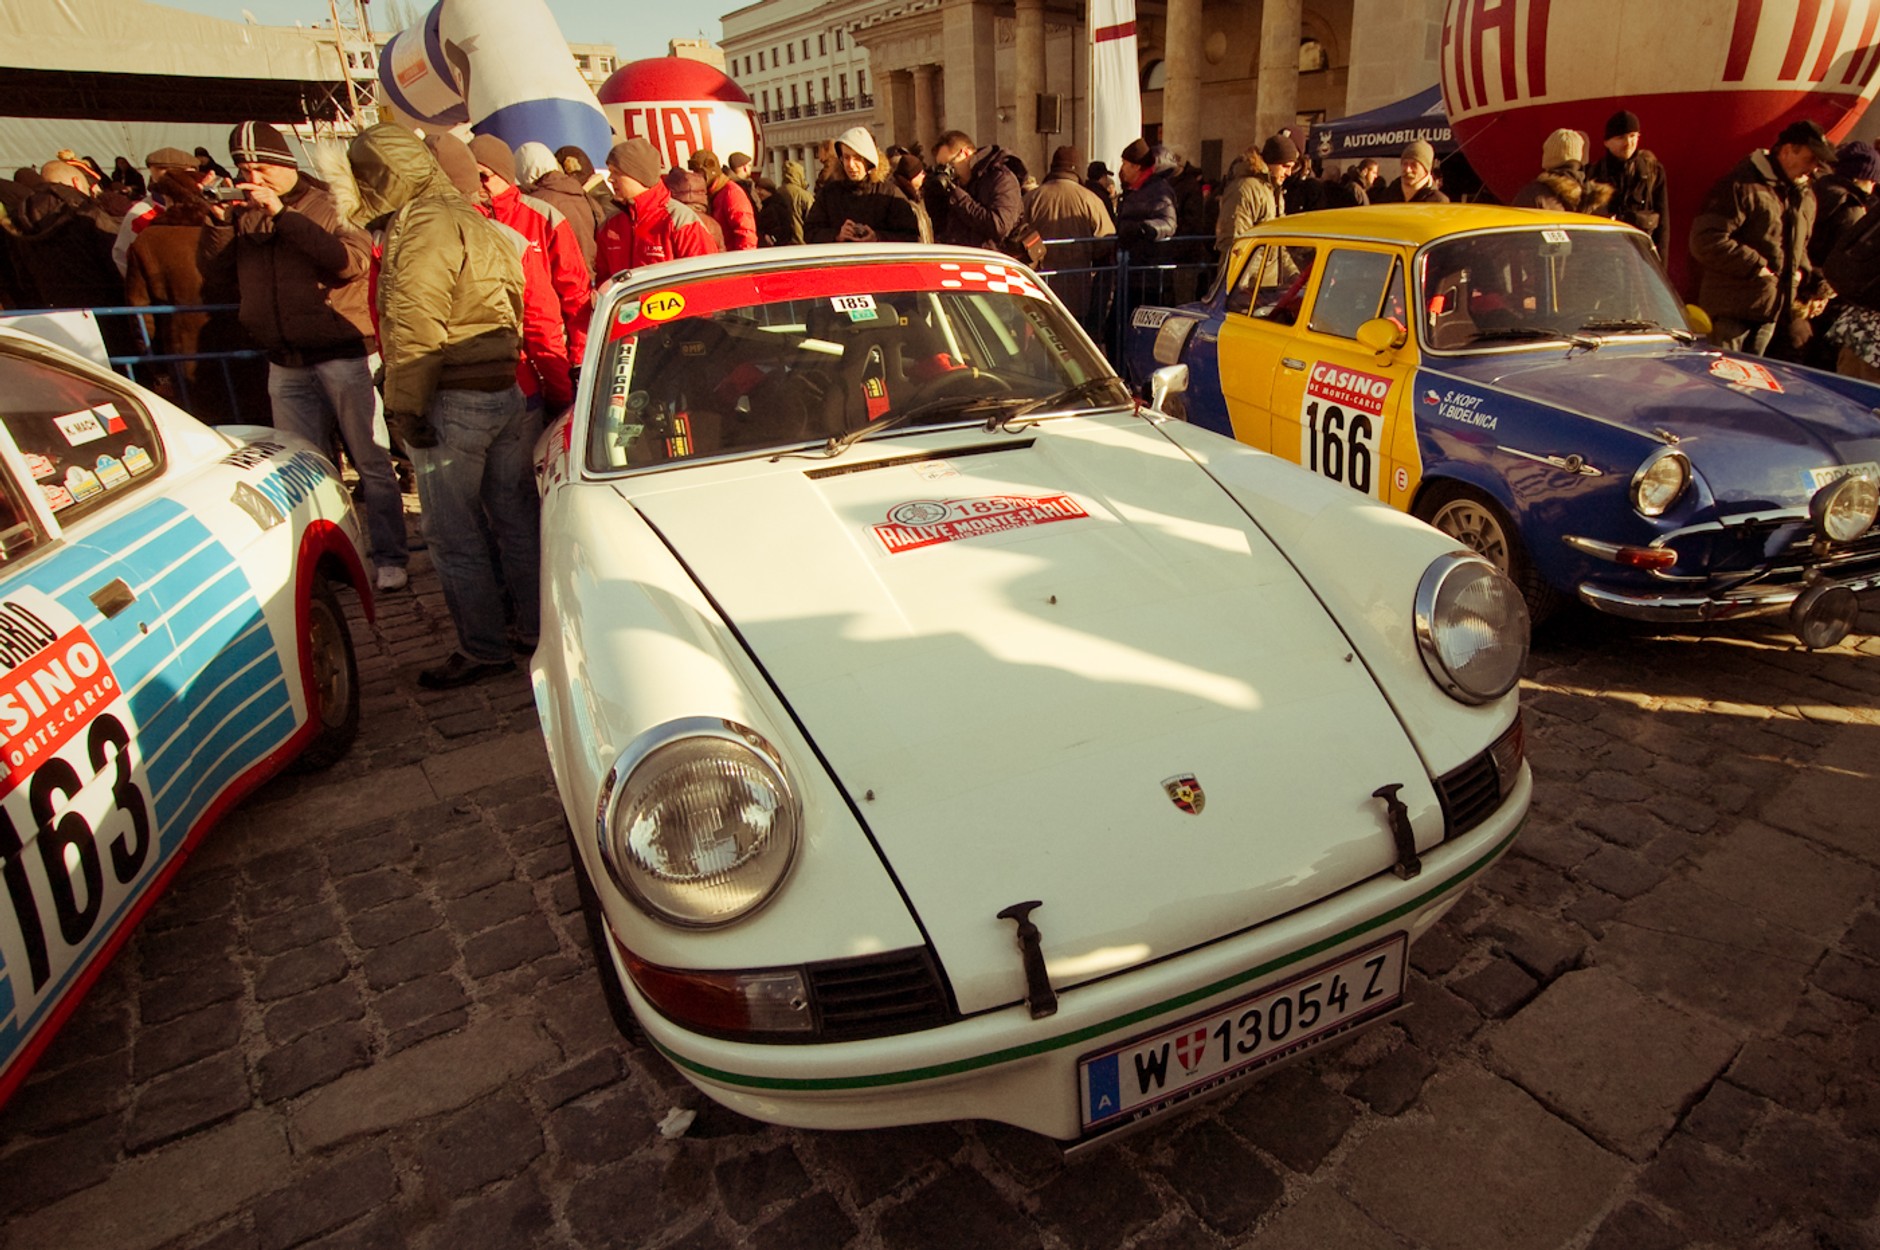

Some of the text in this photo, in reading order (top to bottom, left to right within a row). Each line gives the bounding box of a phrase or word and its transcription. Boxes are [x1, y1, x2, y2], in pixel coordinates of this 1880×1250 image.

[624, 107, 716, 169] FIAT
[1344, 128, 1452, 148] AUTOMOBILKLUB
[646, 297, 682, 315] FIA
[838, 297, 870, 310] 185
[612, 345, 634, 395] HEIGO
[1313, 365, 1388, 399] CASINO
[1309, 383, 1382, 412] DE MONTE-CARLO
[1443, 390, 1484, 409] S.KOPT
[1437, 402, 1499, 431] V.BIDELNICA
[1306, 400, 1373, 495] 166
[1398, 471, 1406, 488] E
[876, 522, 954, 549] RALLYE
[953, 496, 1085, 534] MONTE-CARLO
[952, 500, 1011, 517] 185
[0, 675, 114, 782] MONTE-CARLO
[0, 712, 151, 995] 163
[1097, 1094, 1112, 1111] A
[1133, 1041, 1171, 1095] W
[1212, 973, 1350, 1064] 13054
[1361, 954, 1387, 1003] Z
